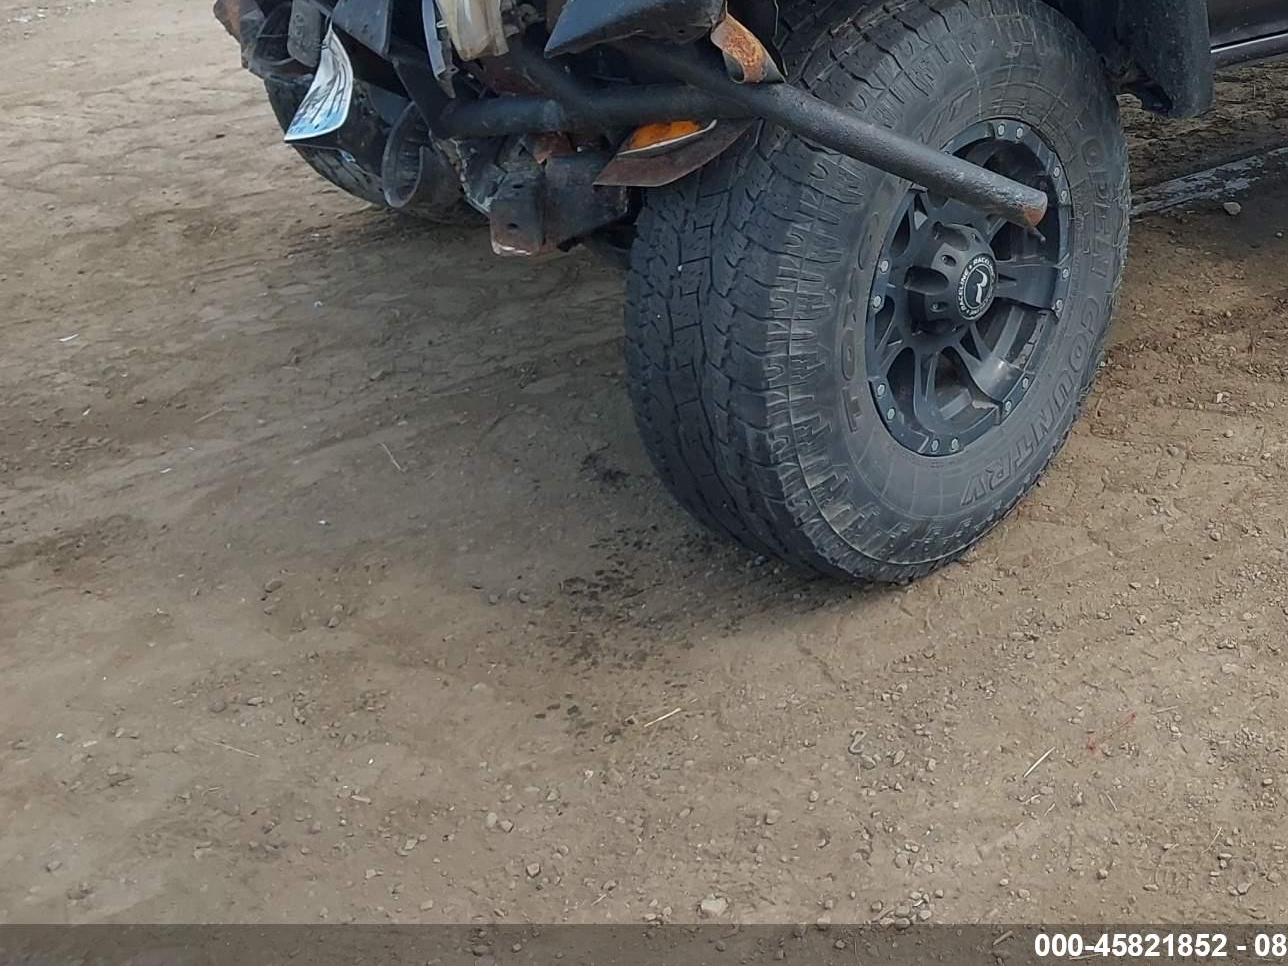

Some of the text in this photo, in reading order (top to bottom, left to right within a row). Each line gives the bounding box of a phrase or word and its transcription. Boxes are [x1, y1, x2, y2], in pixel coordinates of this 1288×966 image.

[1080, 137, 1113, 278] OPEN
[958, 267, 969, 312] RACELINE
[960, 296, 1102, 507] COUNTRY
